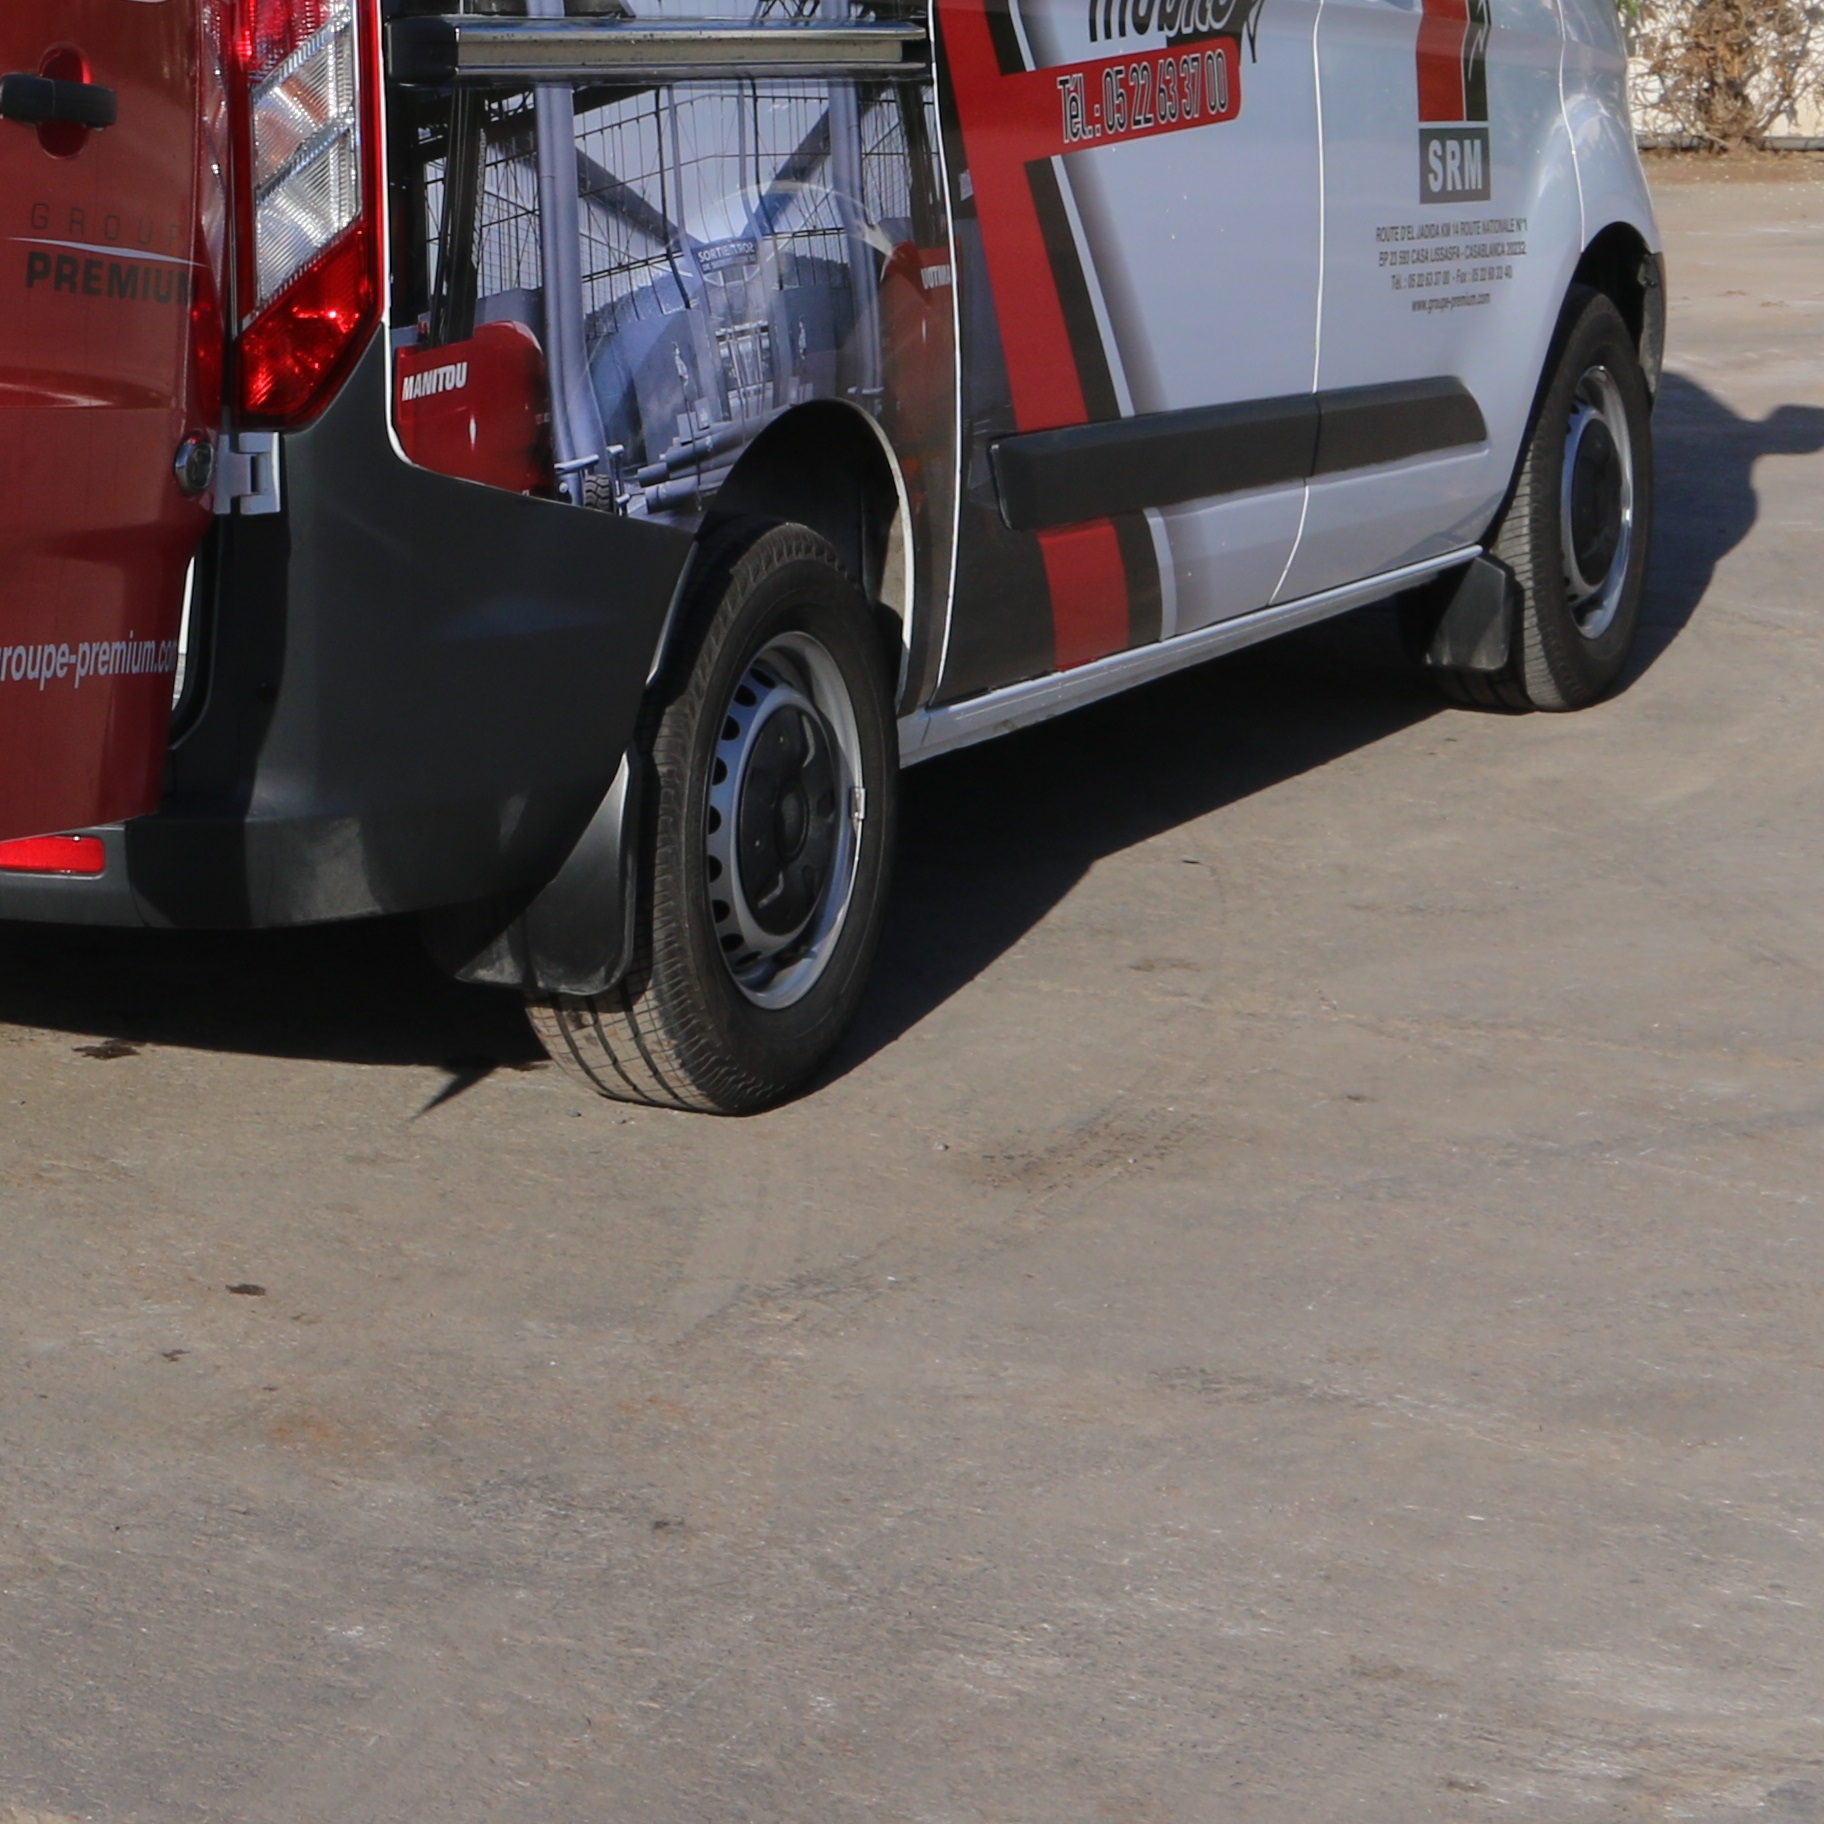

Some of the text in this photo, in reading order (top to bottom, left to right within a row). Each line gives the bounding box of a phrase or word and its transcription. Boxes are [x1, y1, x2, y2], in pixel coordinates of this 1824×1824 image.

[1103, 67, 1127, 134] 05
[1129, 61, 1154, 130] 22
[1156, 57, 1178, 124] 63
[1180, 53, 1201, 119] 37
[1204, 48, 1228, 115] 00
[1428, 139, 1483, 193] SRM
[1376, 226, 1400, 242] ROUTE
[1460, 220, 1481, 236] ROUTE
[1465, 242, 1505, 260] CASABLANCA
[402, 361, 468, 401] MANITOU
